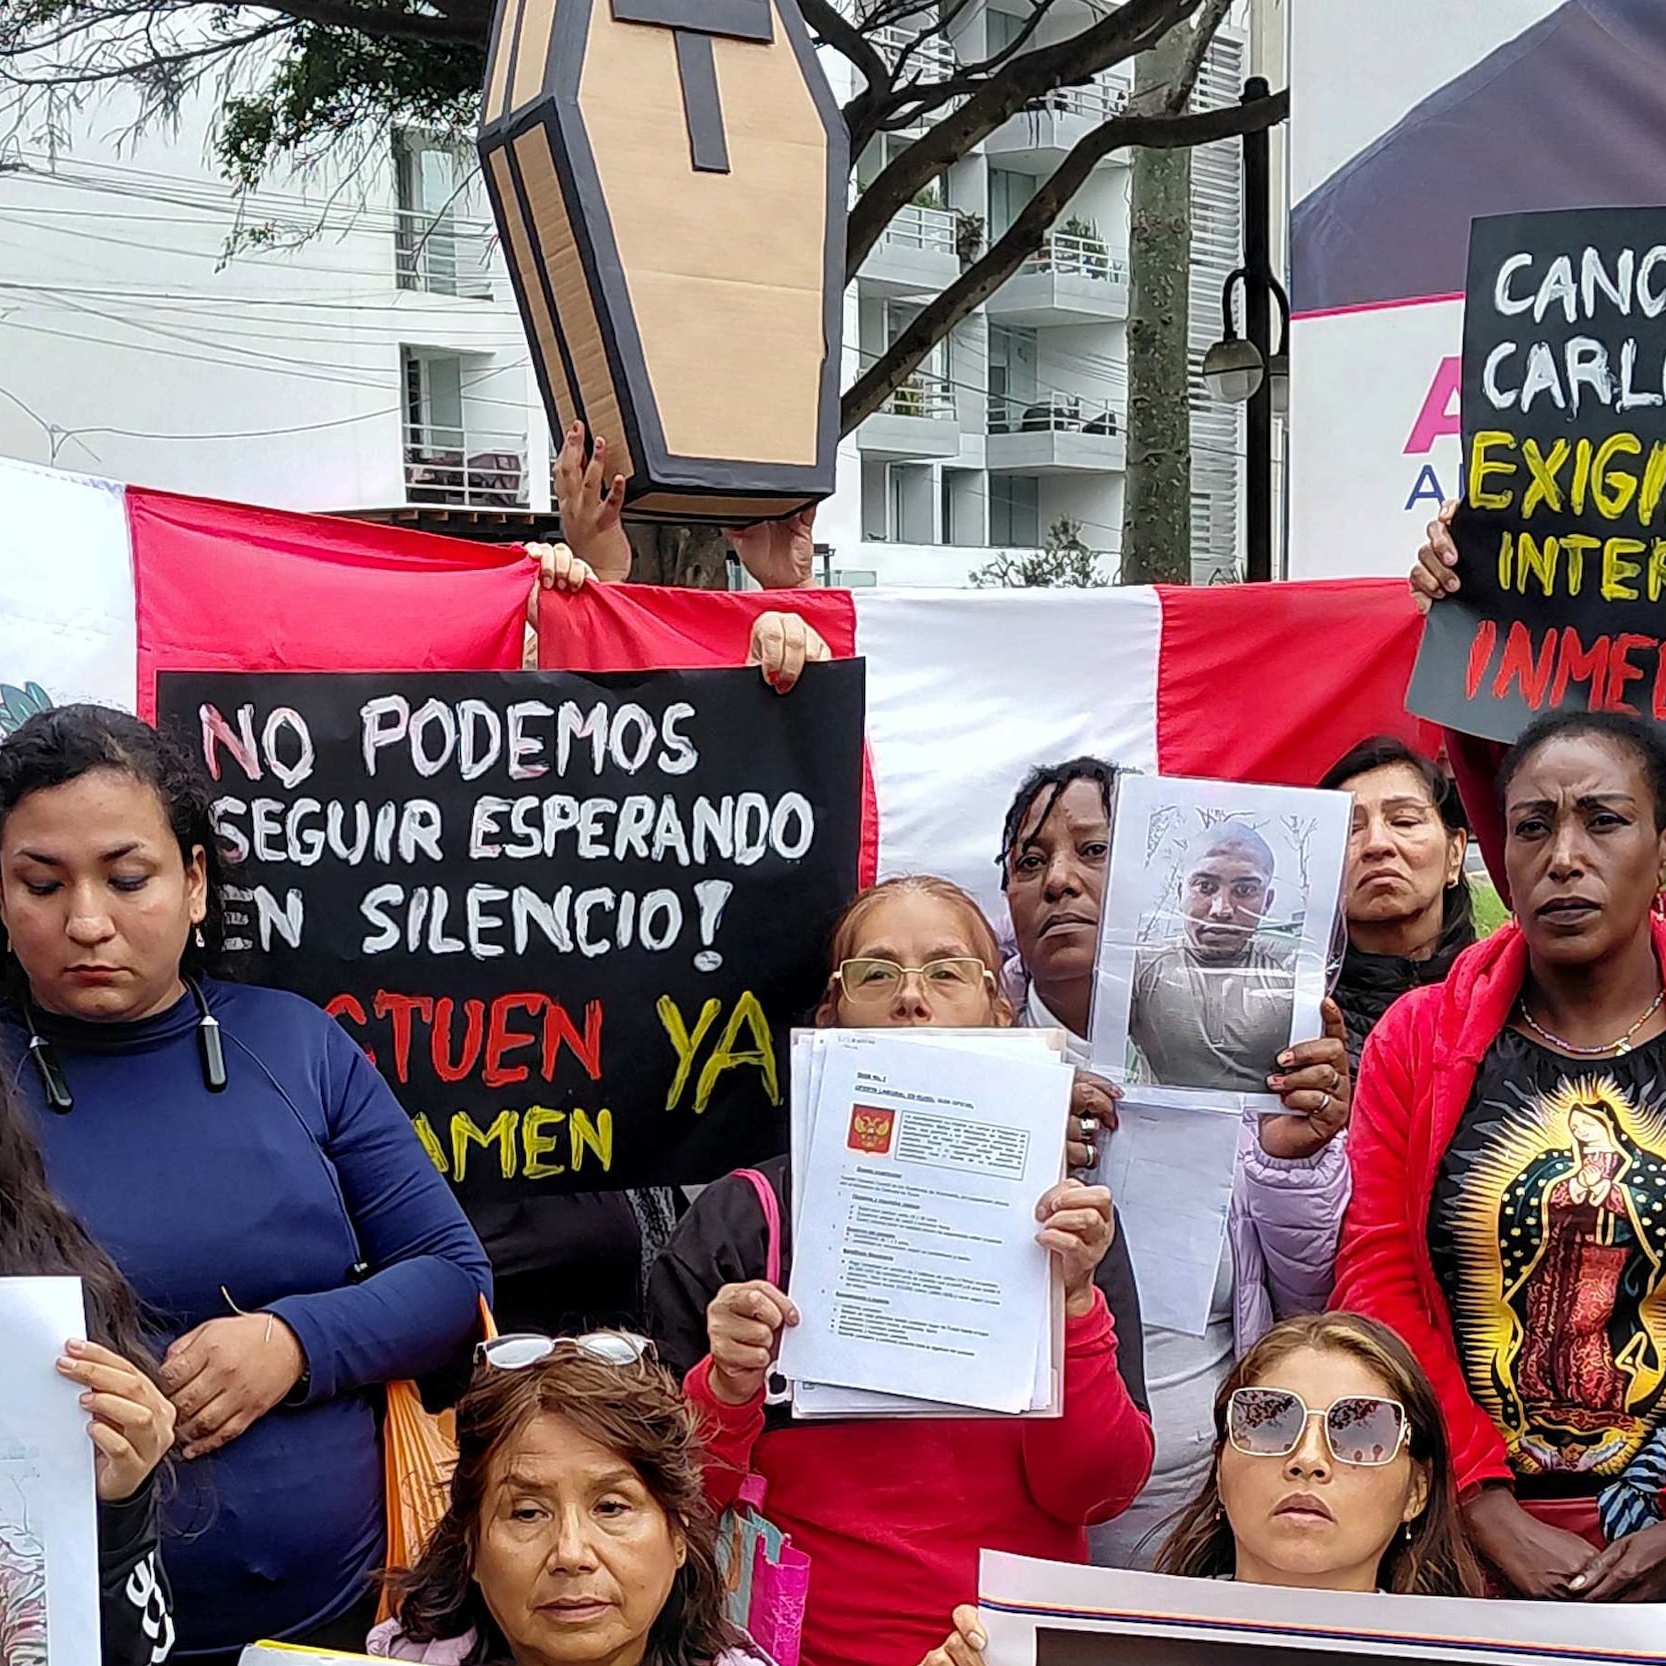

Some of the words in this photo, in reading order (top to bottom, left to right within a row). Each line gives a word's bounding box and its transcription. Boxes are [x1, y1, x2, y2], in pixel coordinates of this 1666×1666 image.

[200, 703, 317, 788] NO
[359, 694, 699, 780] PODEMOS
[207, 795, 443, 865] SEGUIR
[468, 790, 814, 867] ESPERANDO
[221, 884, 304, 953] EN
[359, 880, 734, 973] SILENCIO!
[323, 989, 603, 1088] TUEN
[656, 990, 785, 1113] YA
